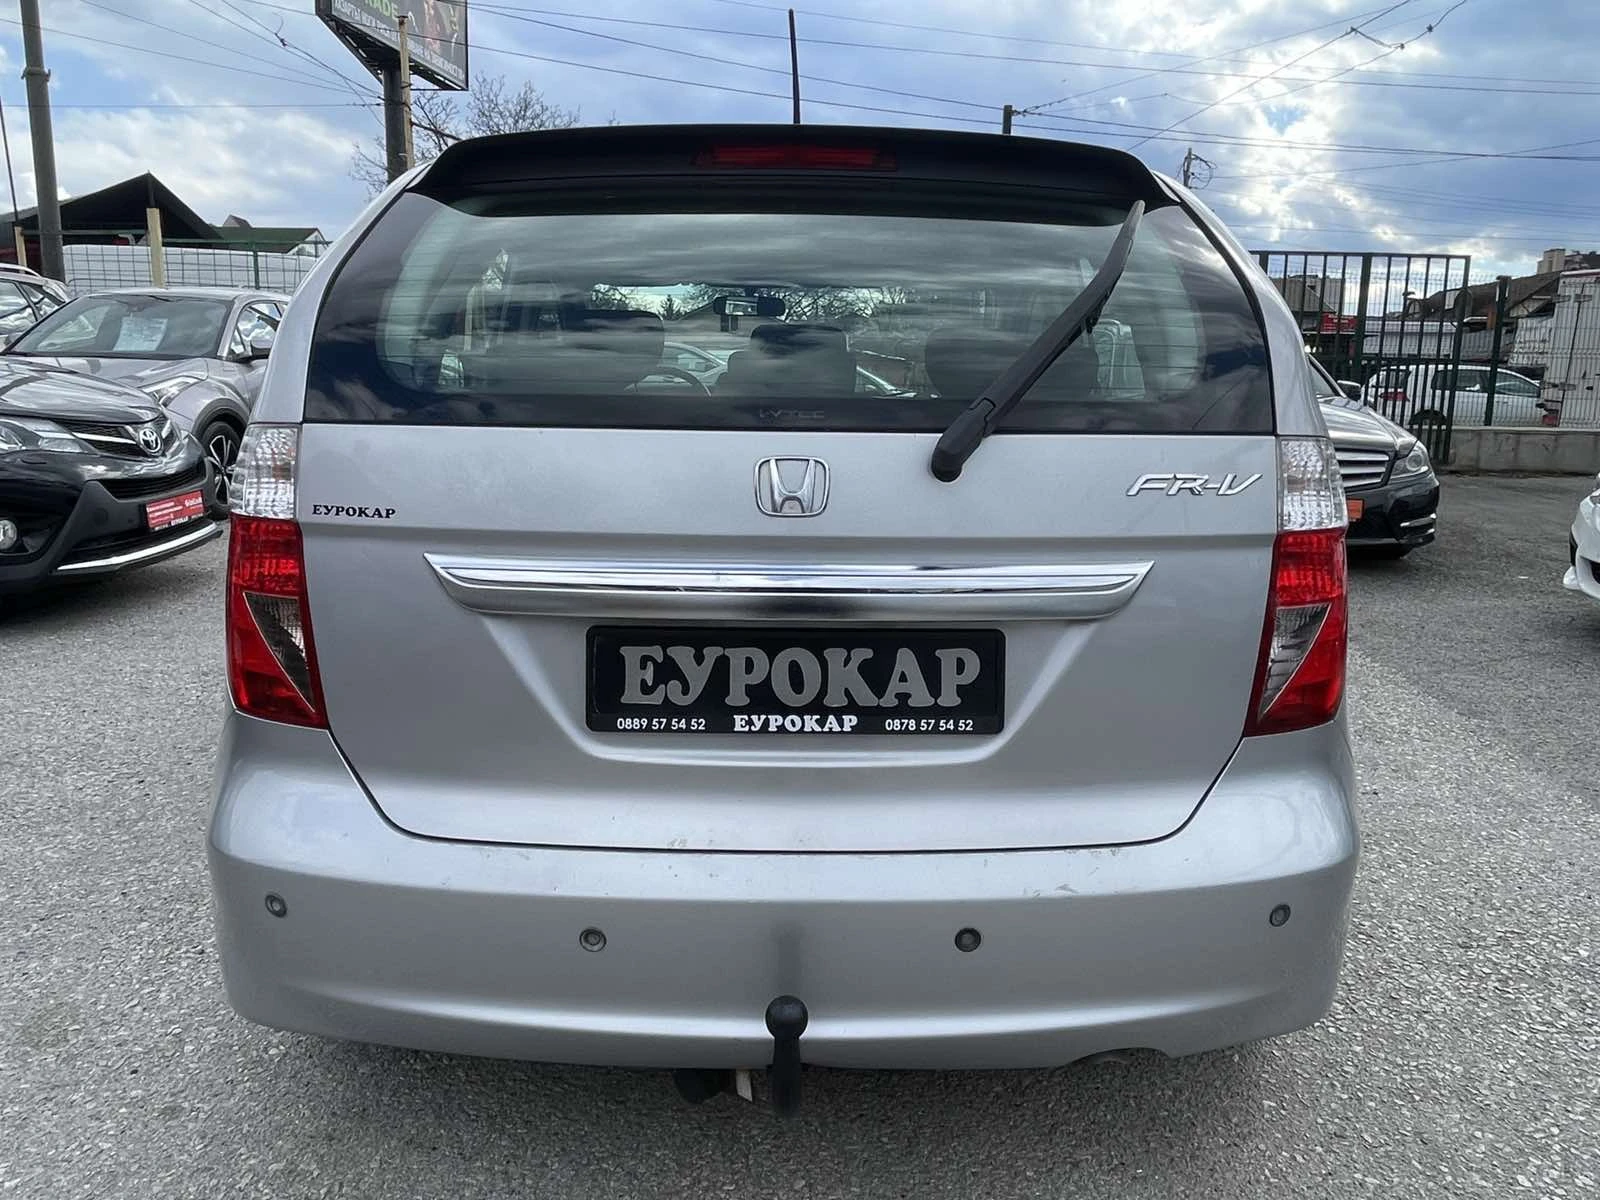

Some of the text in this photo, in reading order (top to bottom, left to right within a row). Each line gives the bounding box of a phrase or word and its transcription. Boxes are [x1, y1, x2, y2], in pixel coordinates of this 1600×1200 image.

[1126, 473, 1263, 496] FR-V
[312, 504, 396, 519] ЕУРОКАР
[619, 645, 981, 707] ЕУРОКАР
[616, 718, 706, 730] 0889 57 54 52
[733, 714, 858, 732] ЕУРОКАР
[885, 719, 974, 731] 0878 57 54 52
